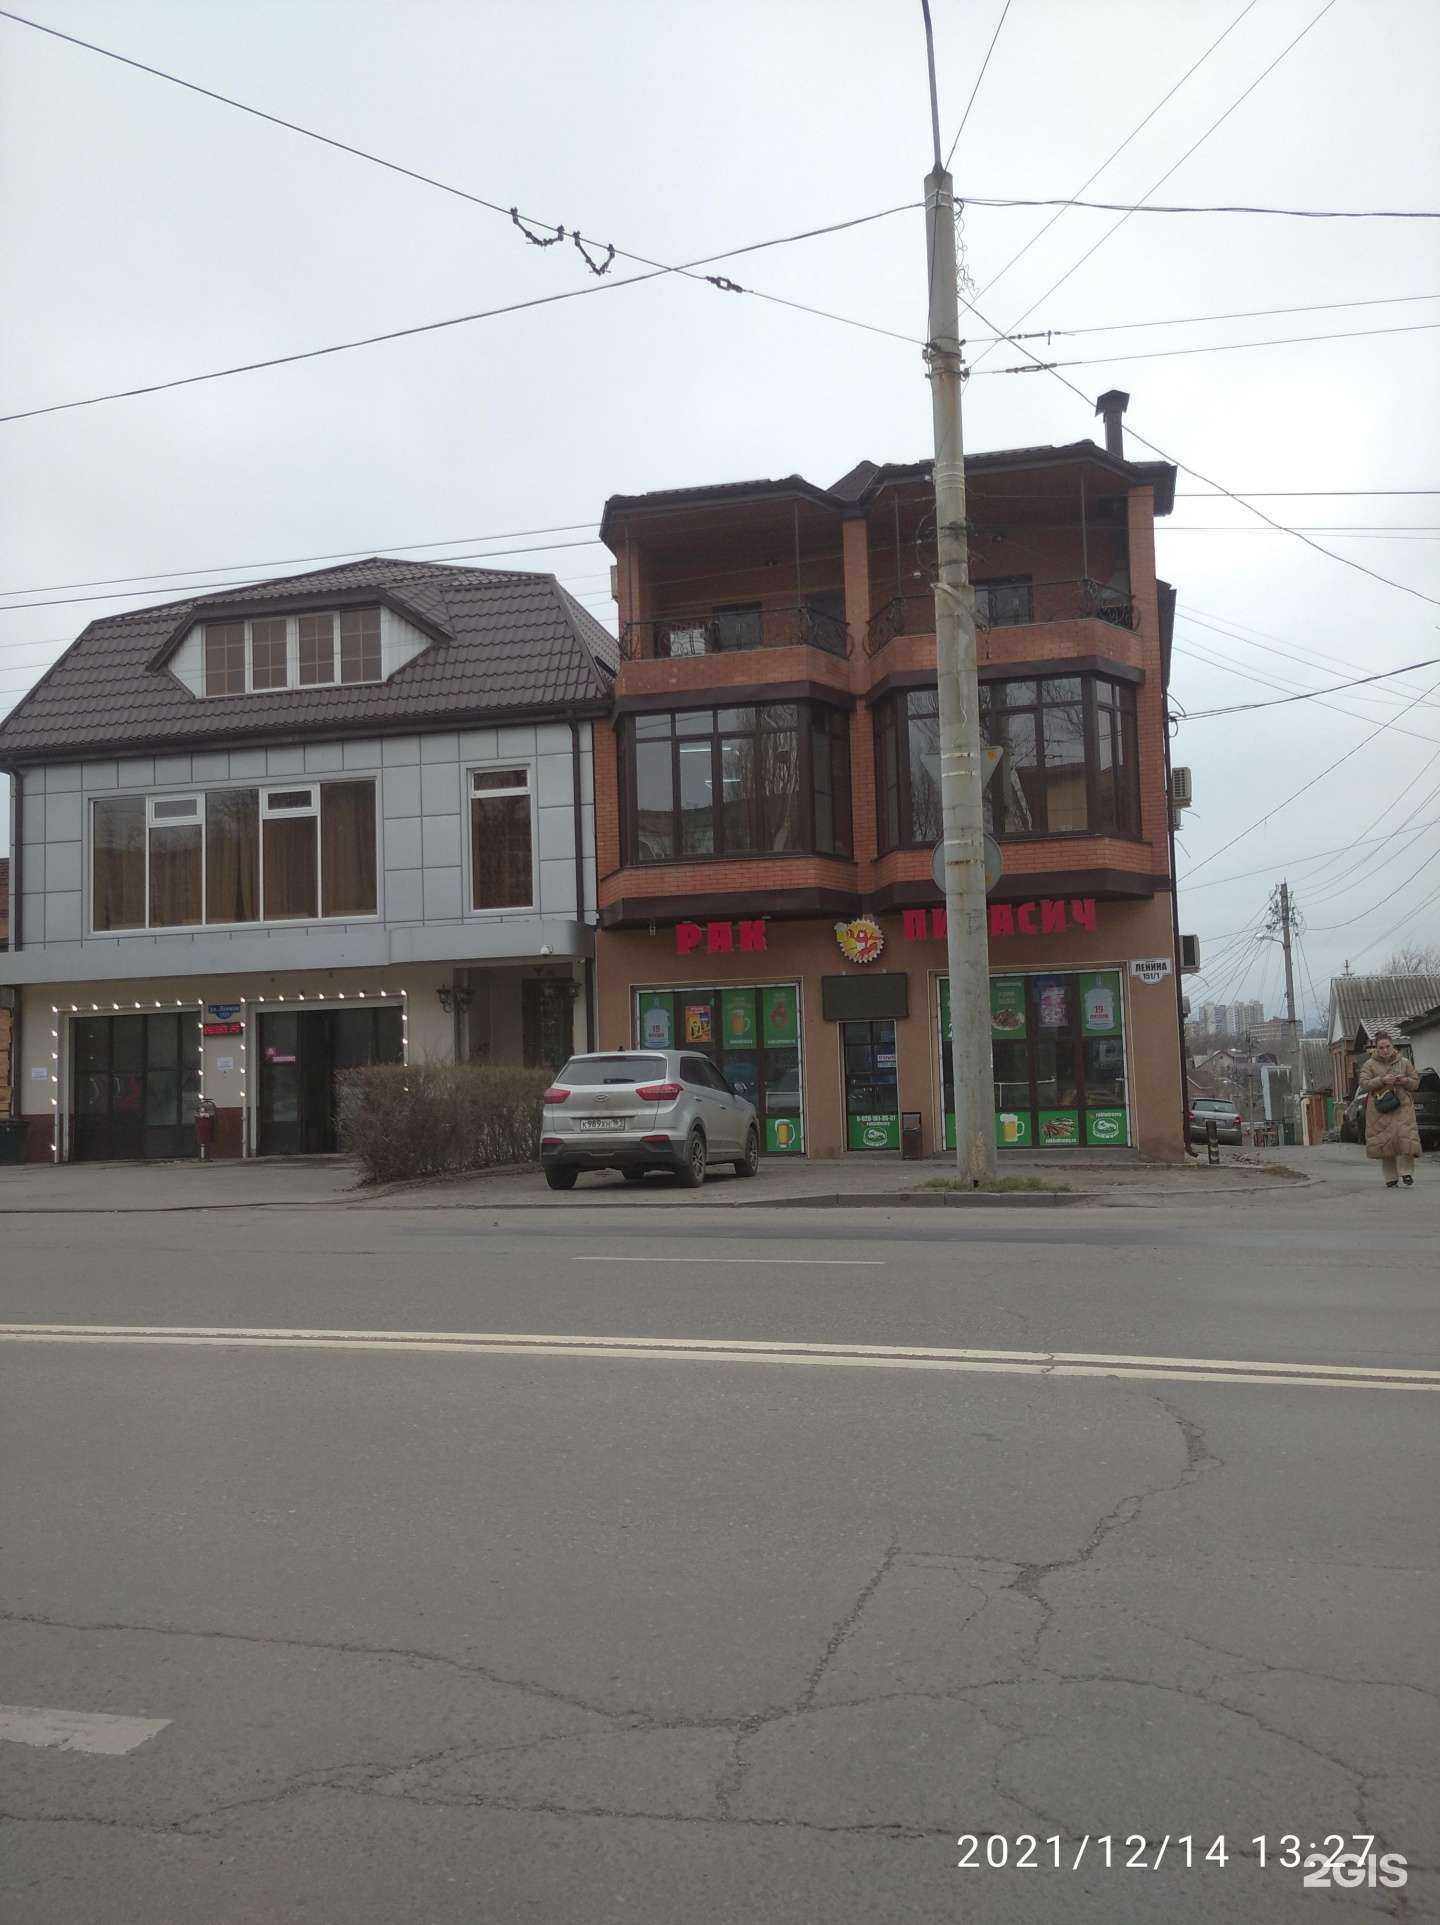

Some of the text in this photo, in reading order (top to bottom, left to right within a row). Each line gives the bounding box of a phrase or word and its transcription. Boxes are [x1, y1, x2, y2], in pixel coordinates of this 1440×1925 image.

[675, 898, 1097, 955] РАК ПИАСИЧ
[1135, 962, 1167, 971] ЛЕНИНА
